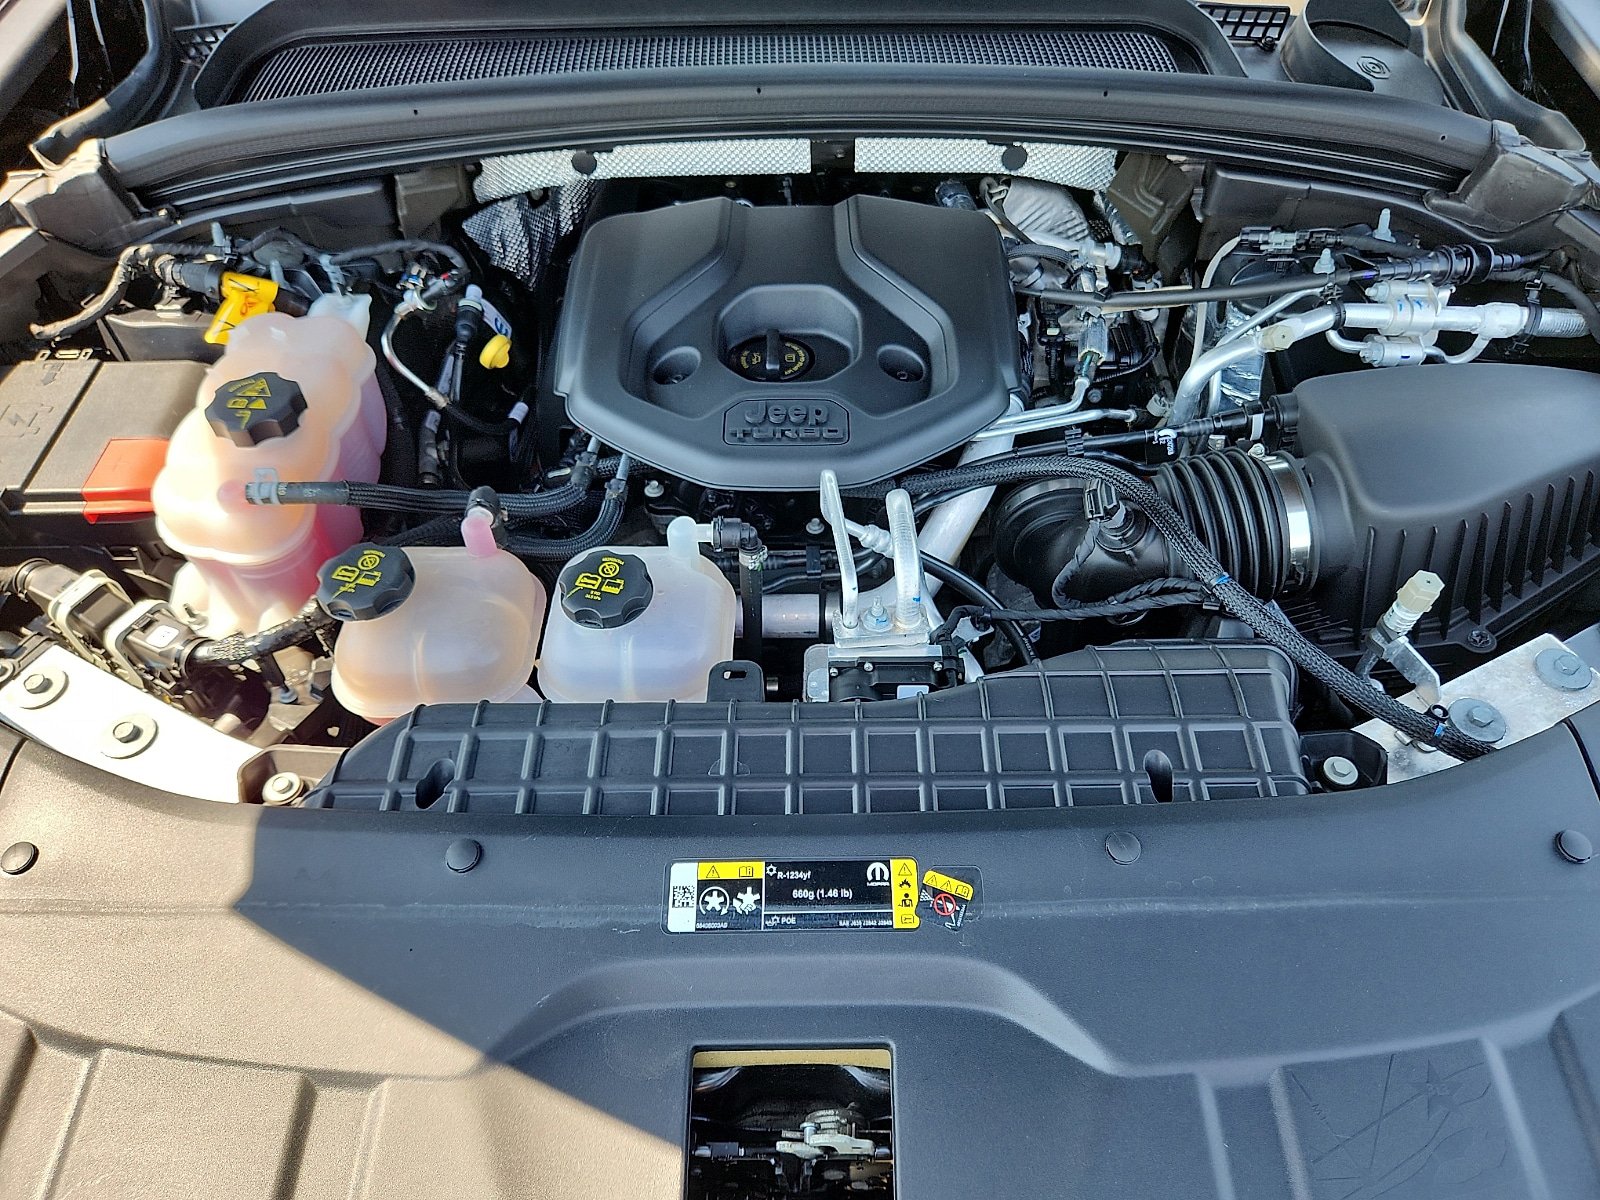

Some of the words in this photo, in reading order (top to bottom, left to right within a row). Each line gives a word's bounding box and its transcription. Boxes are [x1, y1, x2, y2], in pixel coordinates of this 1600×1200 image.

[744, 400, 829, 426] Jeep
[730, 427, 844, 441] TURBO
[776, 870, 812, 881] R-1234yf
[792, 888, 815, 900] 660g
[816, 888, 839, 900] (1.46
[841, 887, 853, 900] lb)
[780, 916, 797, 925] POE
